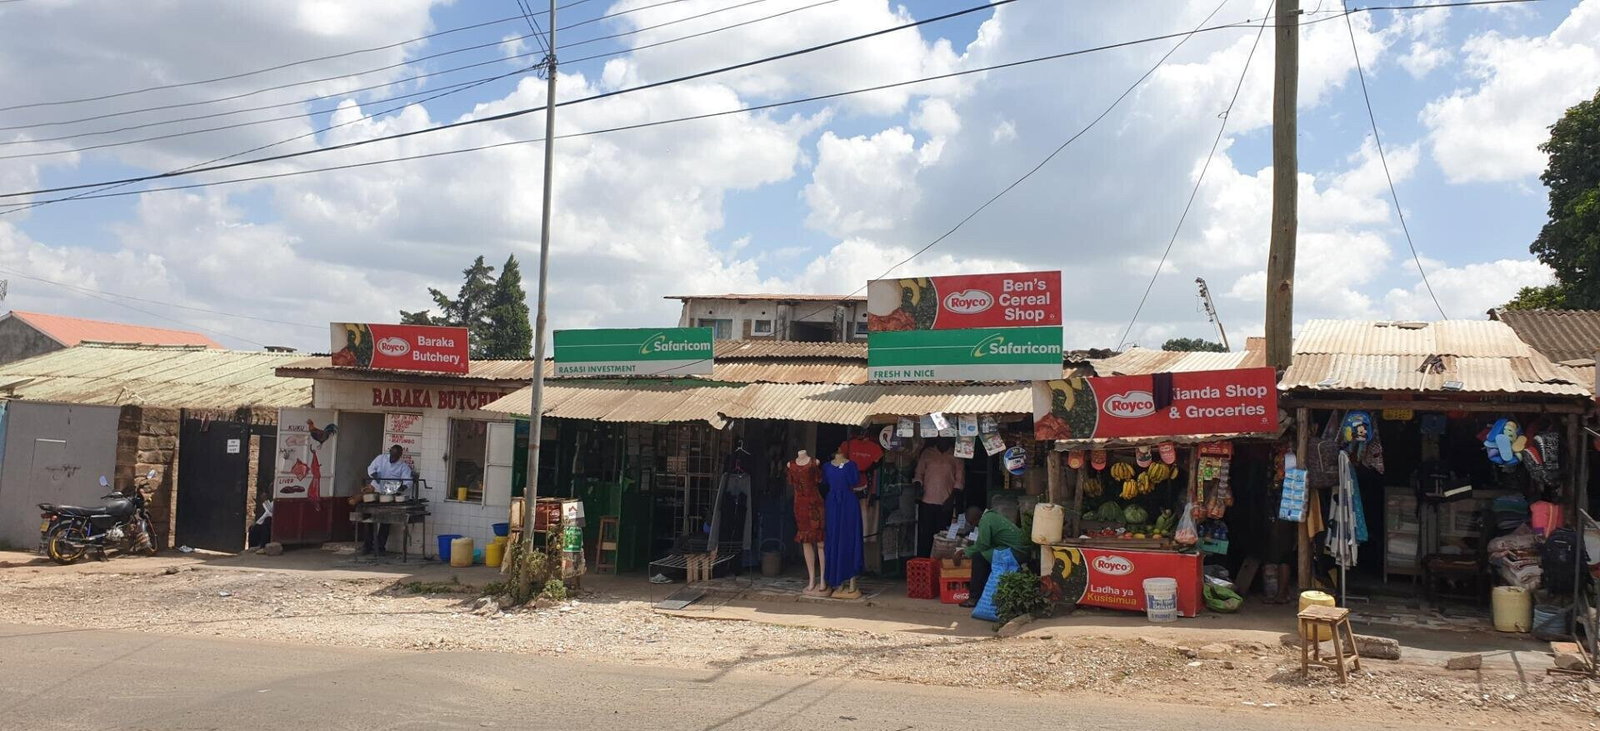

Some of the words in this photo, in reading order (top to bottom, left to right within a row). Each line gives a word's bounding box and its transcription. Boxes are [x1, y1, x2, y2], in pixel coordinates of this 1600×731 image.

[1003, 279, 1047, 292] Ben's
[951, 297, 987, 309] Royco
[999, 293, 1050, 306] Cereal
[1004, 307, 1045, 321] Shop
[381, 342, 404, 352] Royco
[418, 336, 454, 347] Baraka
[654, 340, 711, 351] Safaricom
[989, 341, 1060, 355] Safaricom
[413, 350, 460, 364] Butchery
[558, 366, 585, 374] RASASI
[588, 365, 636, 373] INVESTMENT
[874, 370, 900, 378] FRESH
[904, 370, 911, 378] N
[372, 388, 432, 408] BARAKA
[1226, 385, 1267, 398] Shop
[1112, 401, 1153, 412] Royco
[1169, 408, 1181, 419] &
[1185, 403, 1265, 418] Groceries
[1097, 560, 1128, 571] Royco
[1090, 584, 1119, 595] Ladha
[1122, 588, 1134, 597] ya
[1087, 592, 1137, 605] Kusisimua
